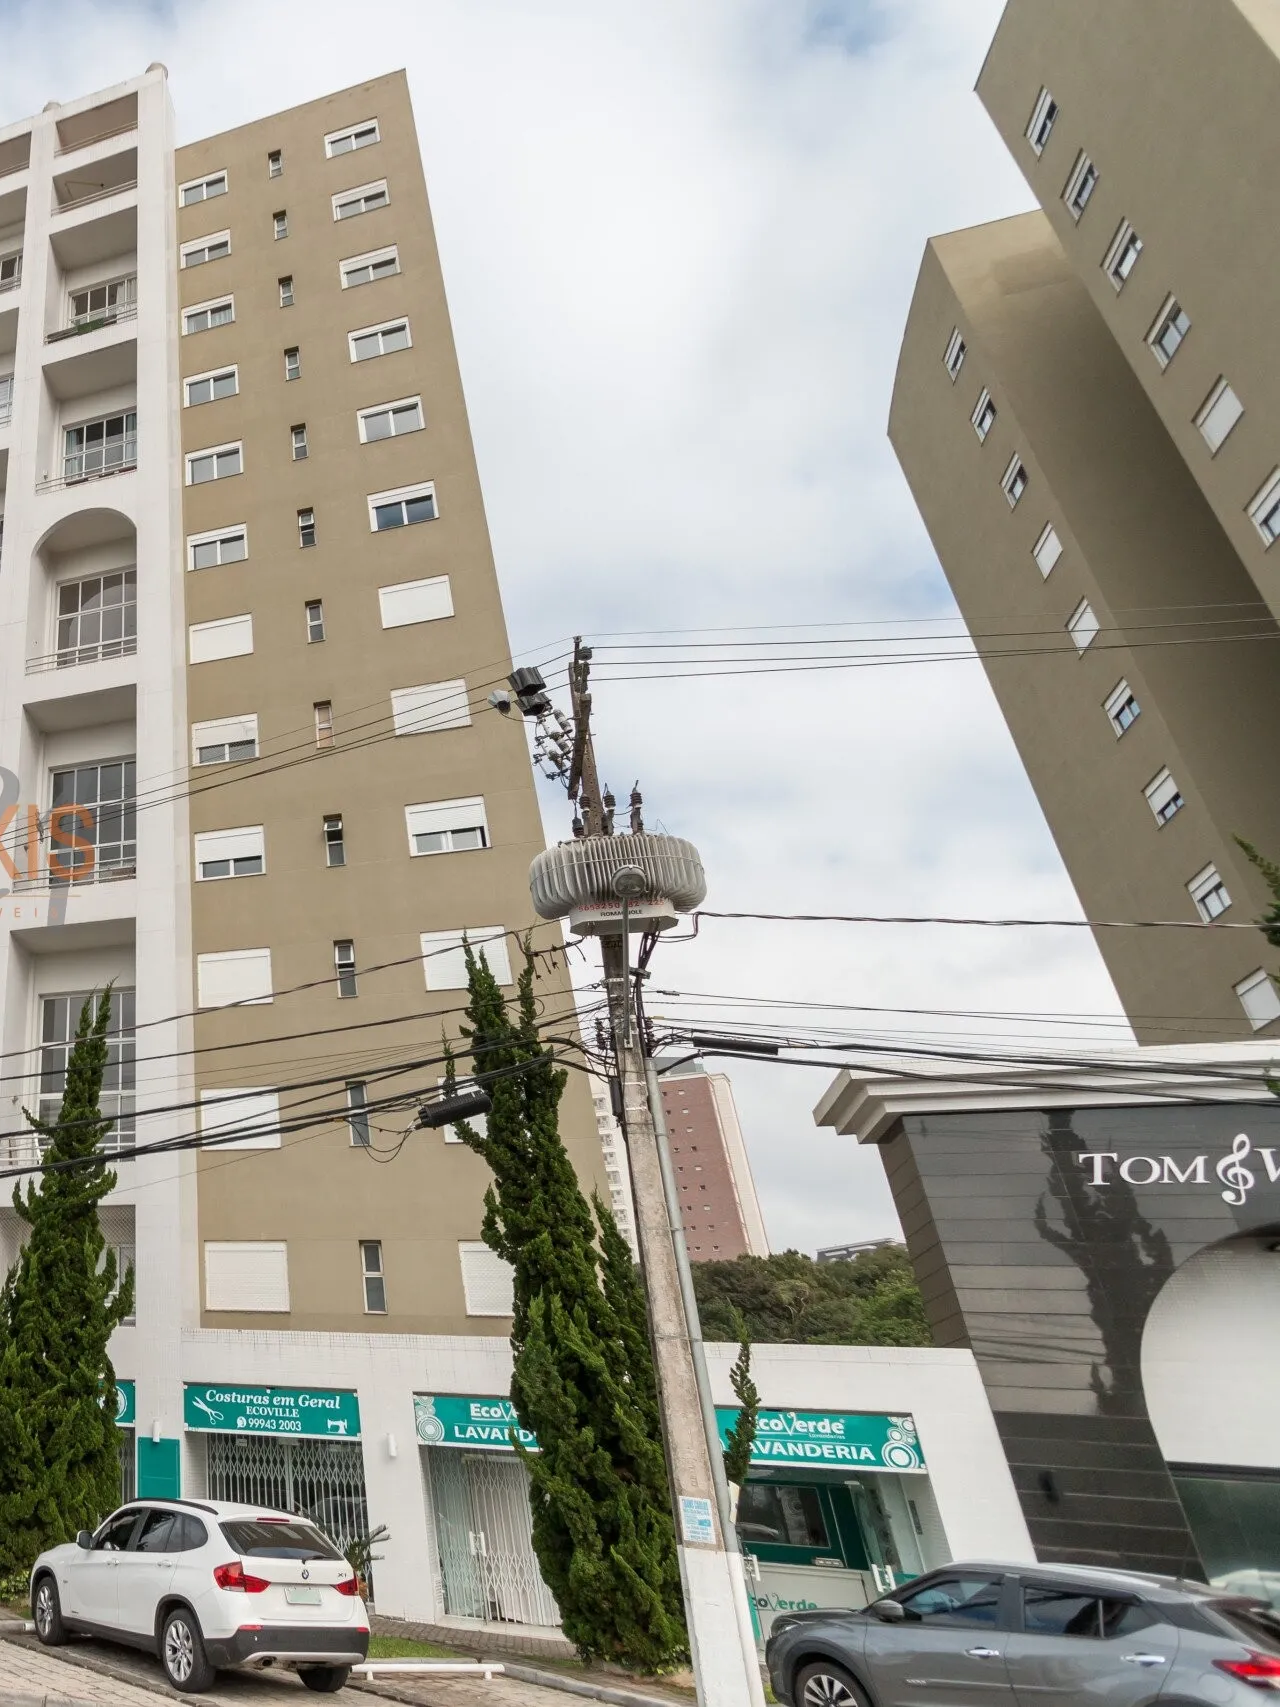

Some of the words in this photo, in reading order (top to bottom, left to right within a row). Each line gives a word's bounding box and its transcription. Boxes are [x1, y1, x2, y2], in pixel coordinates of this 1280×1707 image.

[600, 909, 643, 917] ROMAOLE
[1078, 1152, 1212, 1186] TOM
[206, 1389, 269, 1405] Costuras
[272, 1396, 294, 1407] em
[298, 1394, 341, 1409] Geral
[246, 1406, 300, 1418] ECOVILLE
[248, 1418, 277, 1430] 99943
[279, 1419, 302, 1431] 2003
[754, 1411, 844, 1436] coVerde
[454, 1425, 537, 1442] LAVAND
[749, 1440, 876, 1461] AVANDERIA
